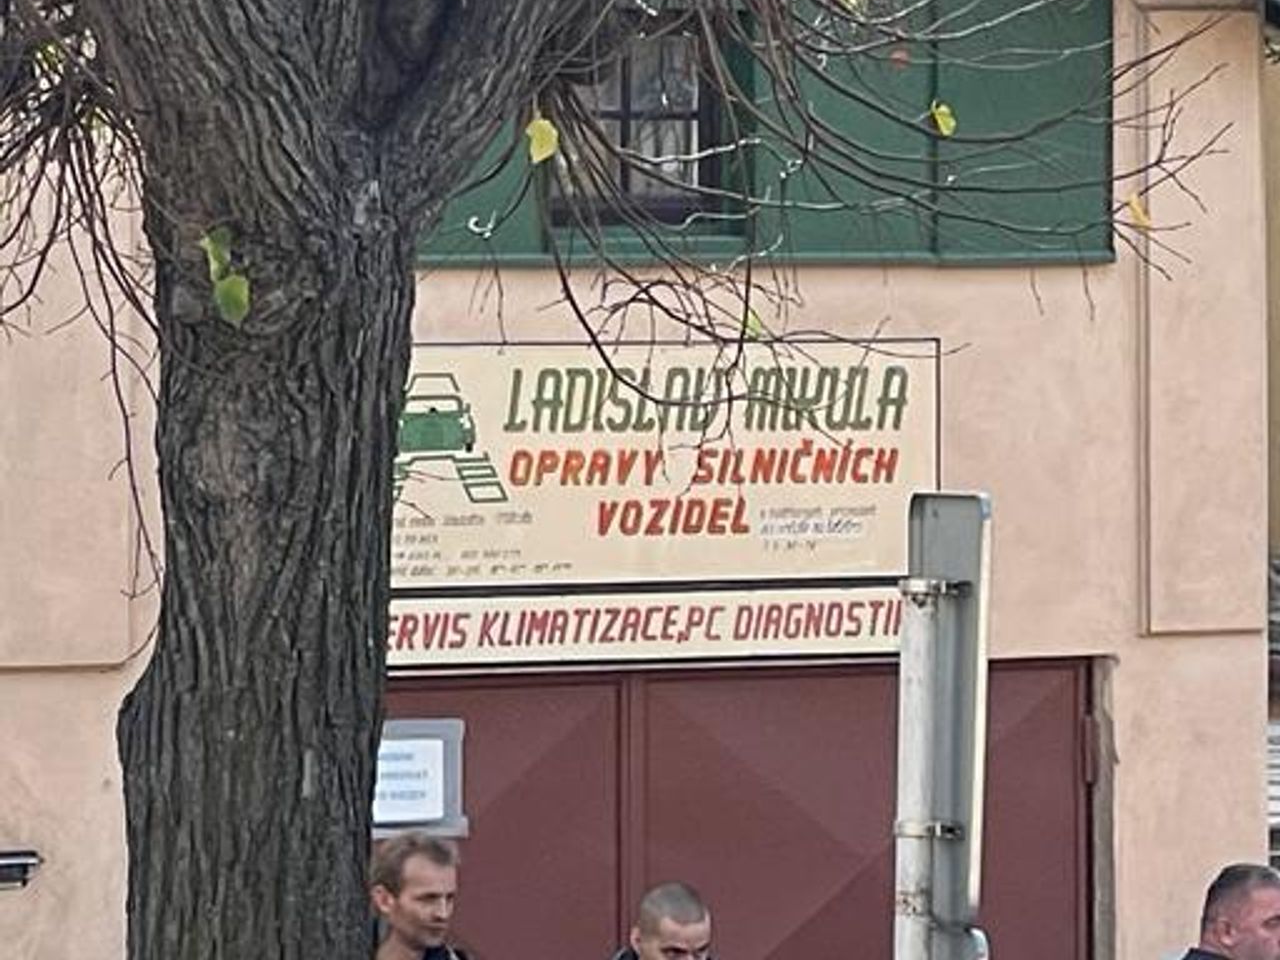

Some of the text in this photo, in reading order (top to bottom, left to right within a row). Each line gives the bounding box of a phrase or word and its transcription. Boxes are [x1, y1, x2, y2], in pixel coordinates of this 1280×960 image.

[509, 438, 899, 486] OPRAVY SILNIČNÍCH
[597, 497, 750, 536] VOZIDEL
